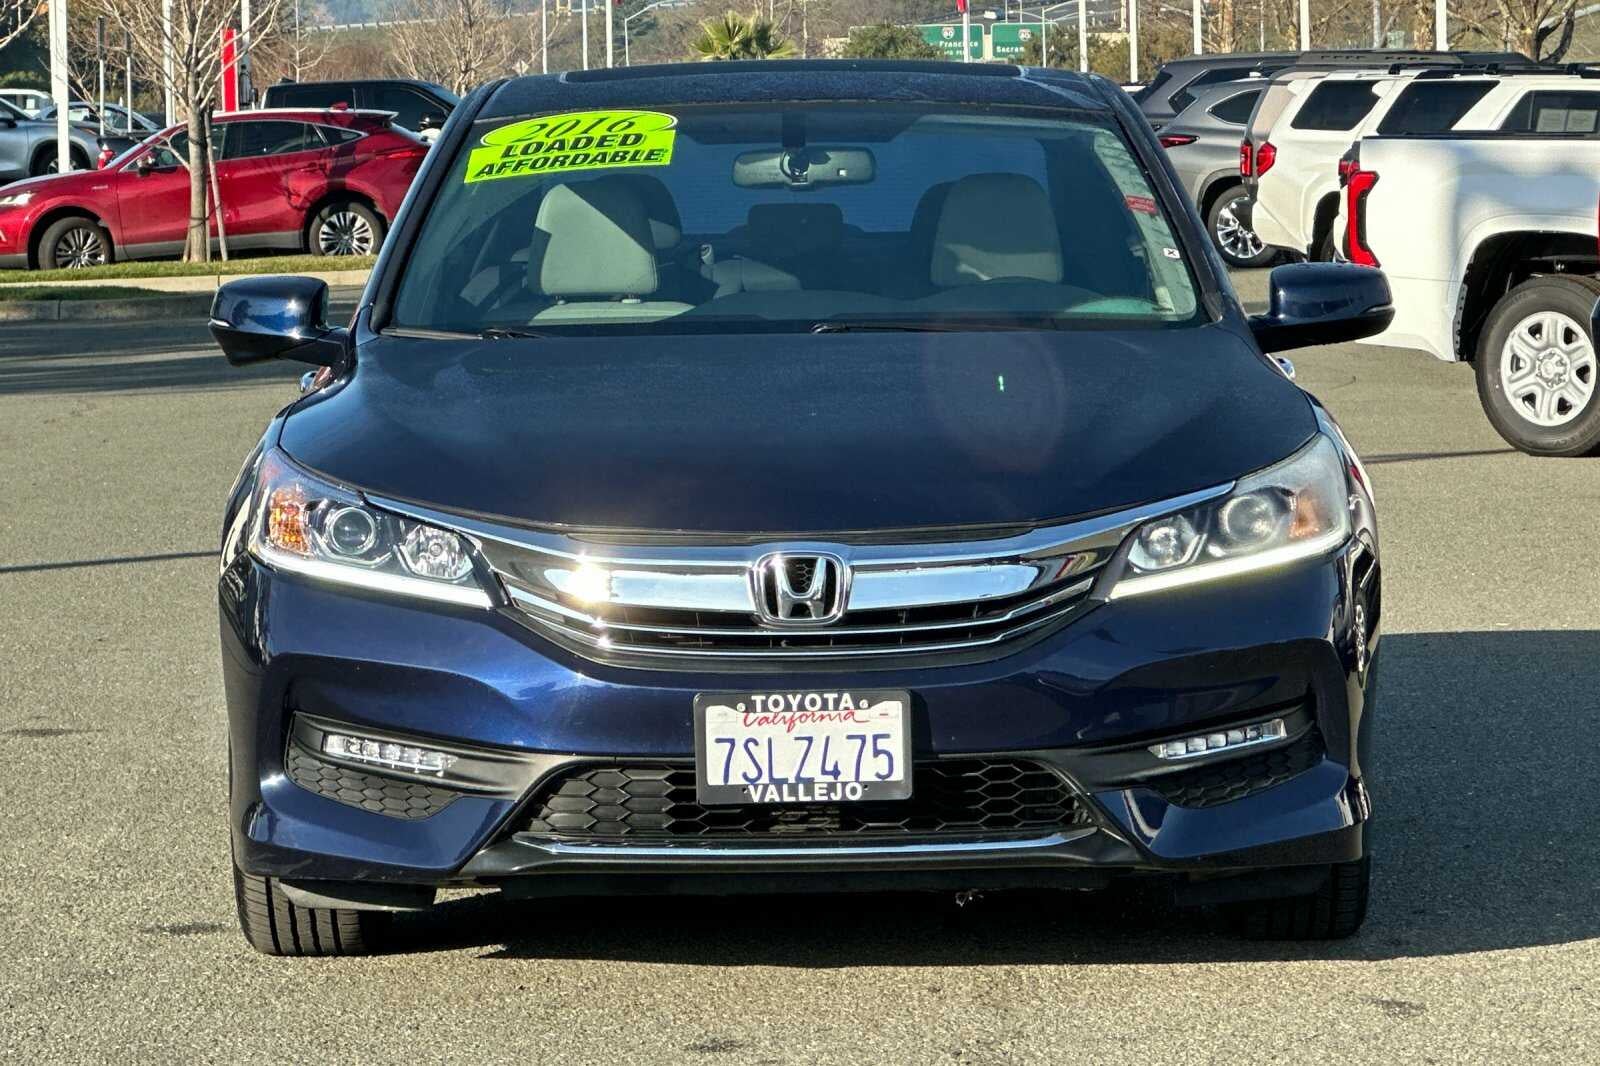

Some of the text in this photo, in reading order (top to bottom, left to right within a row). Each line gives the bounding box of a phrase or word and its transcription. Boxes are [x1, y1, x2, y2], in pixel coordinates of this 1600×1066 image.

[939, 40, 978, 48] Francco
[511, 115, 645, 143] 2016
[501, 133, 646, 159] LOADED
[475, 148, 667, 178] AFFORDABLE
[751, 693, 855, 713] TOYOTA
[742, 709, 870, 733] California
[714, 733, 894, 785] 7SLZ475
[748, 782, 863, 803] VALLEJO
